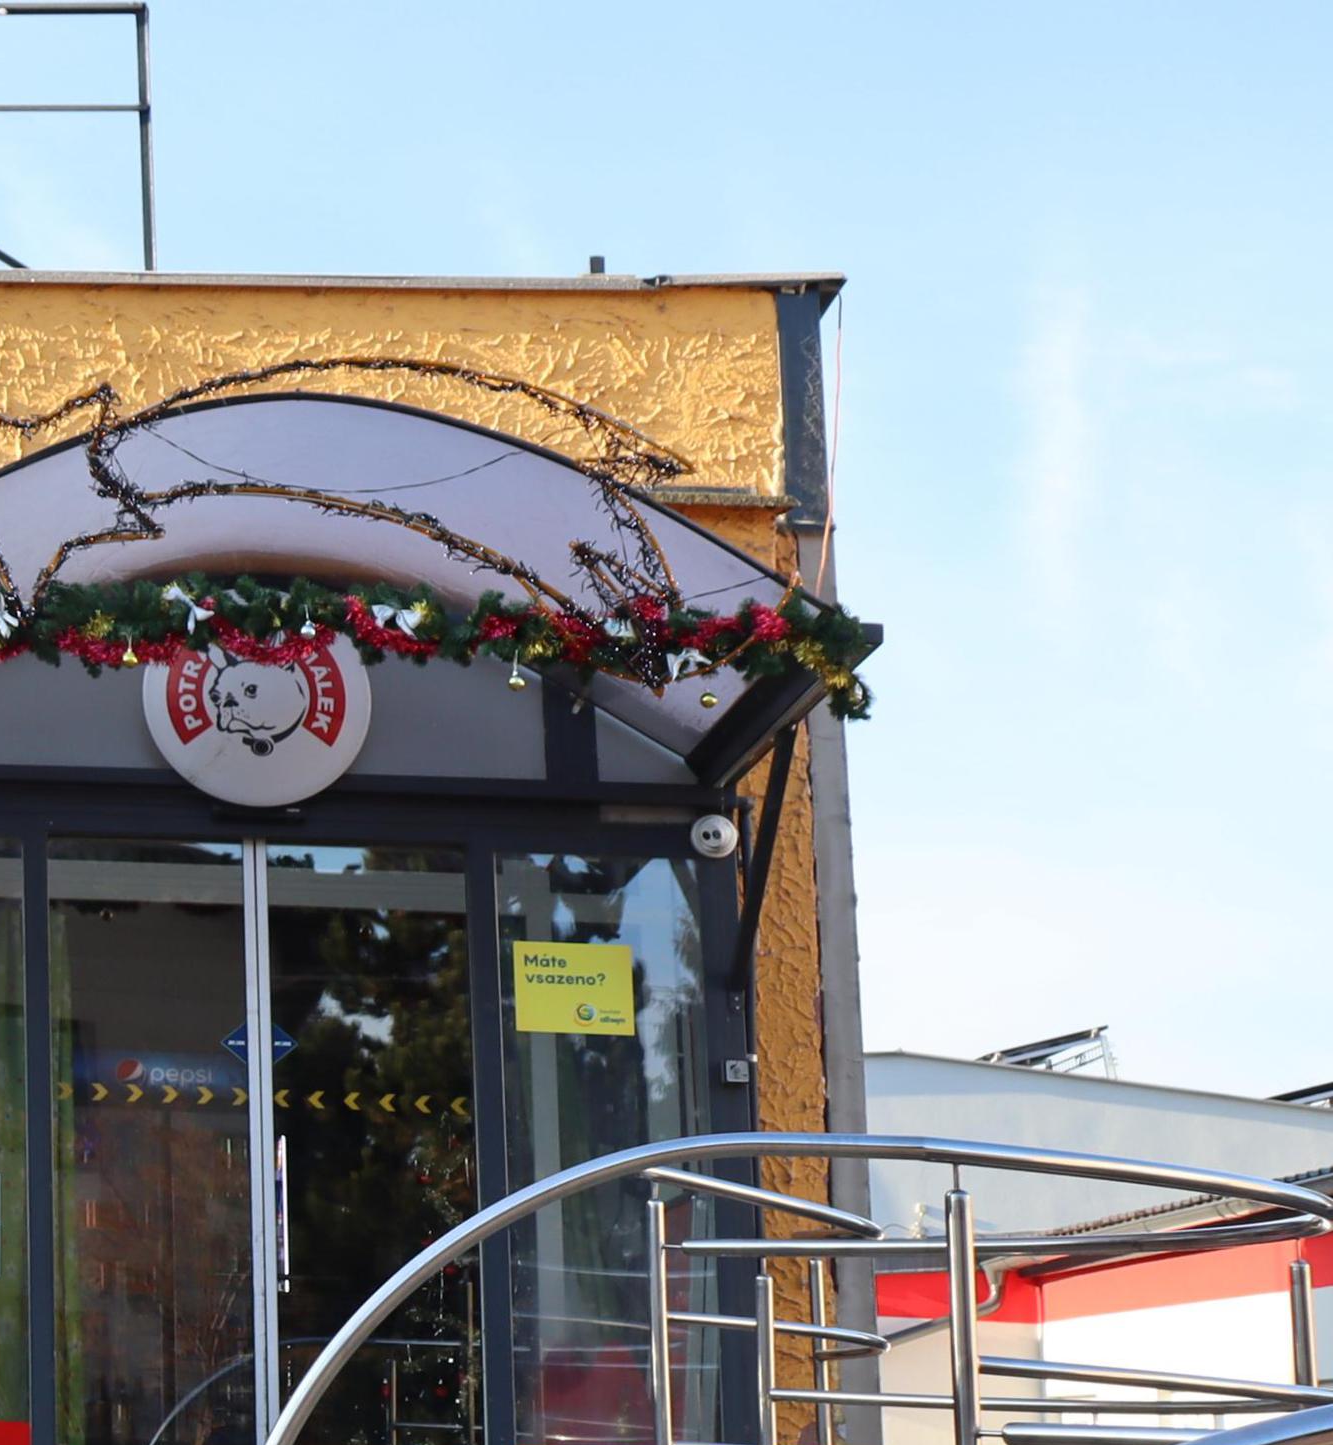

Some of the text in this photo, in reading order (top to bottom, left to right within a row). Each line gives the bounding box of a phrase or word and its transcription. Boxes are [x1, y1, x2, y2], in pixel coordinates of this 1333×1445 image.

[524, 953, 567, 968] Máte
[525, 973, 606, 986] vsazeno?
[149, 1066, 213, 1088] pepsi
